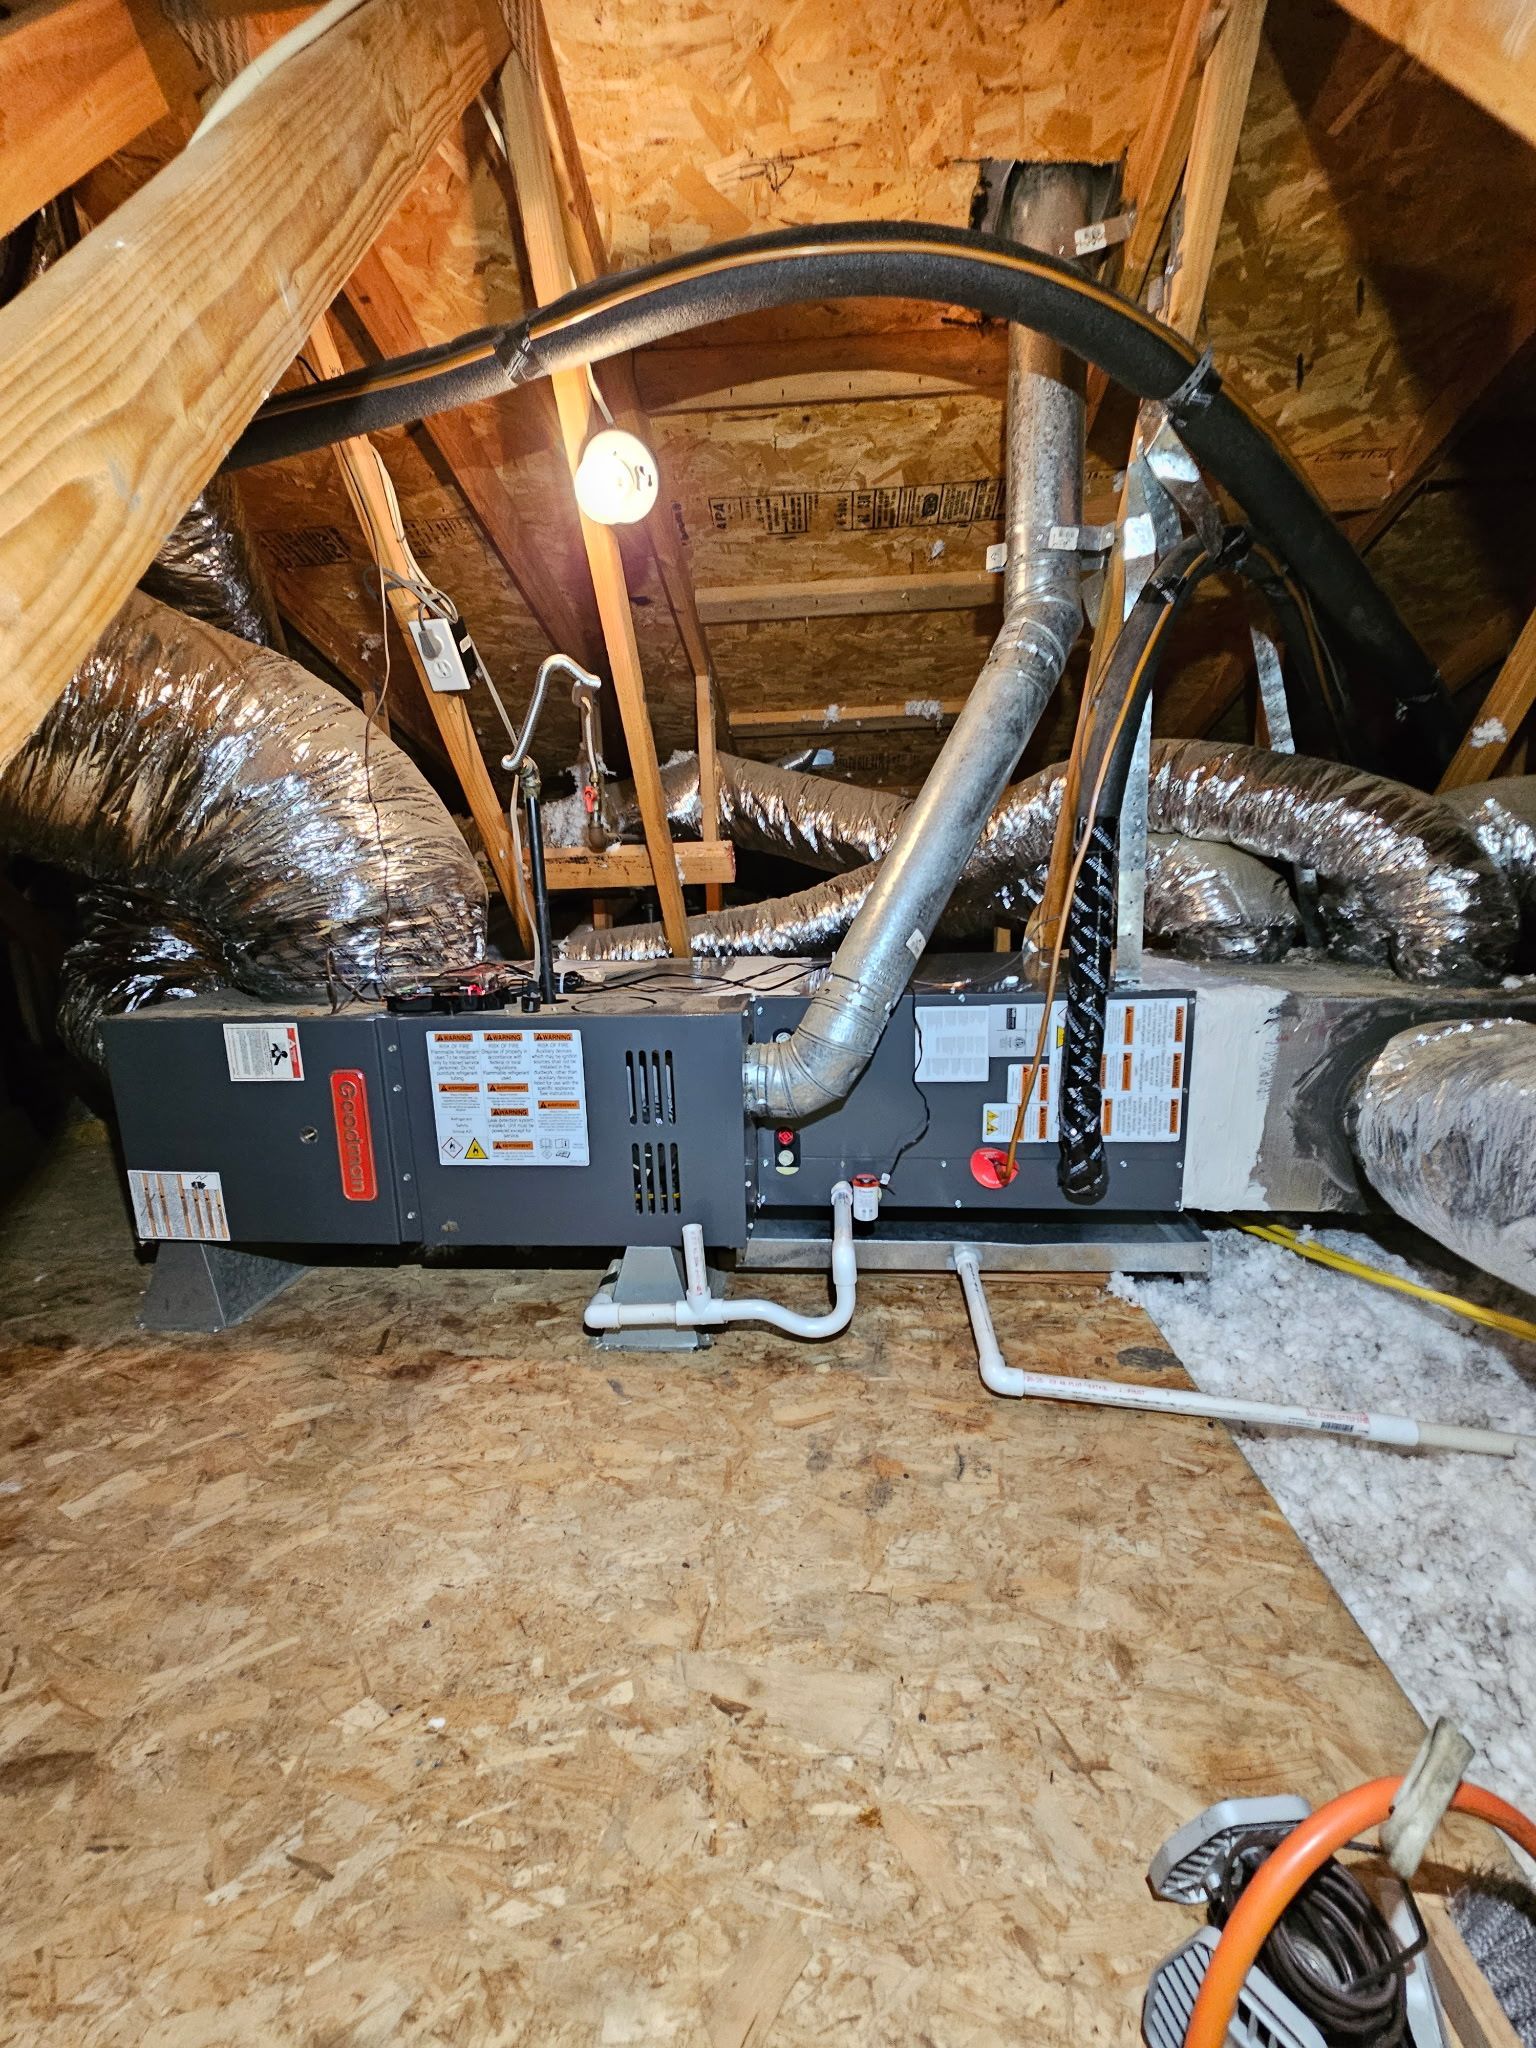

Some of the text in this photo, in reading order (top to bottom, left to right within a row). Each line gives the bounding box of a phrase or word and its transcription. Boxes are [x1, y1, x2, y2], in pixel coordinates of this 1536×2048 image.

[493, 1033, 521, 1041] WARNING
[543, 1033, 572, 1041] WARNING
[1175, 1014, 1183, 1043] WARNING
[1040, 1075, 1048, 1101] WARNING
[1172, 1061, 1180, 1089] WARNING
[339, 1080, 365, 1192] Goodman
[1039, 1113, 1047, 1139] WARNING
